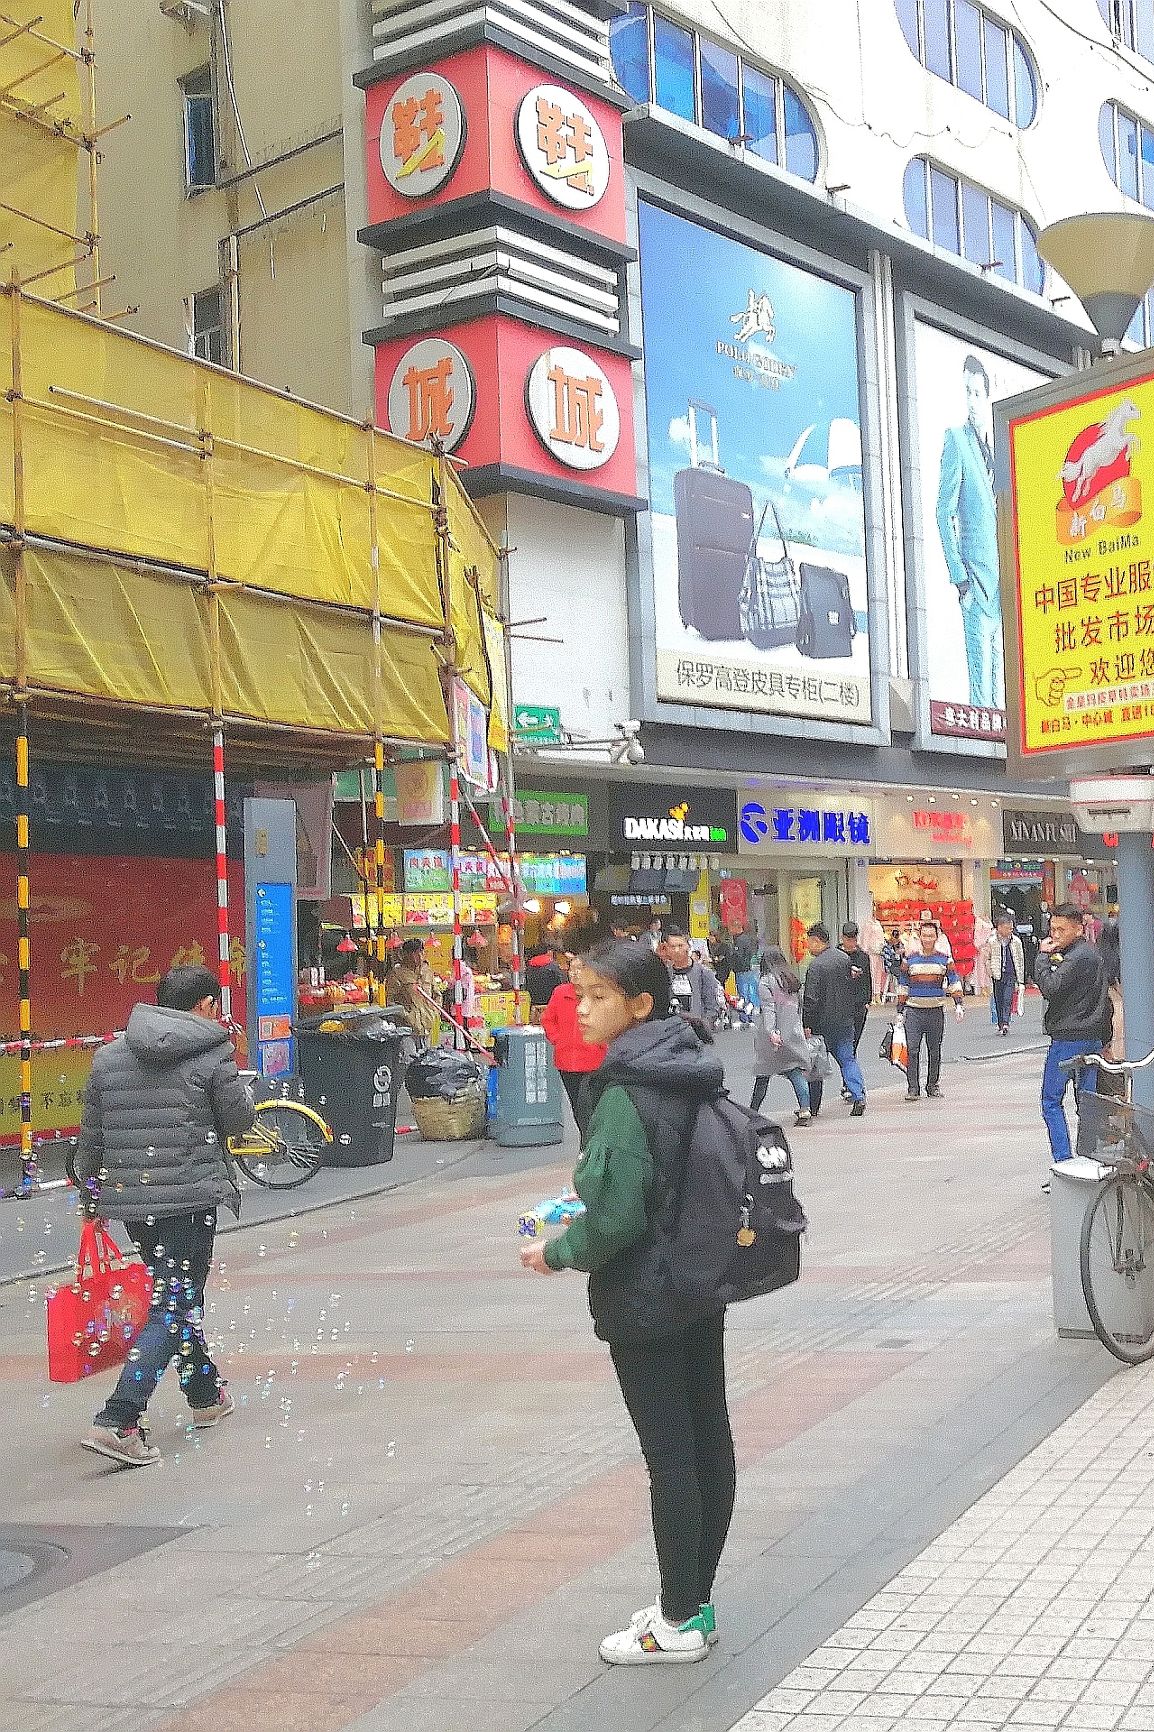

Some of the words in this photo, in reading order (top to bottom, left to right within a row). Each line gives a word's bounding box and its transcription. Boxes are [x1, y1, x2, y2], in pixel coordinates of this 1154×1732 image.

[536, 96, 597, 196] 鞋
[402, 357, 454, 442] 城
[547, 364, 606, 453] 城
[1065, 548, 1092, 564] New
[1098, 533, 1139, 555] BaiMa
[772, 807, 870, 844] 亚洲眼镜
